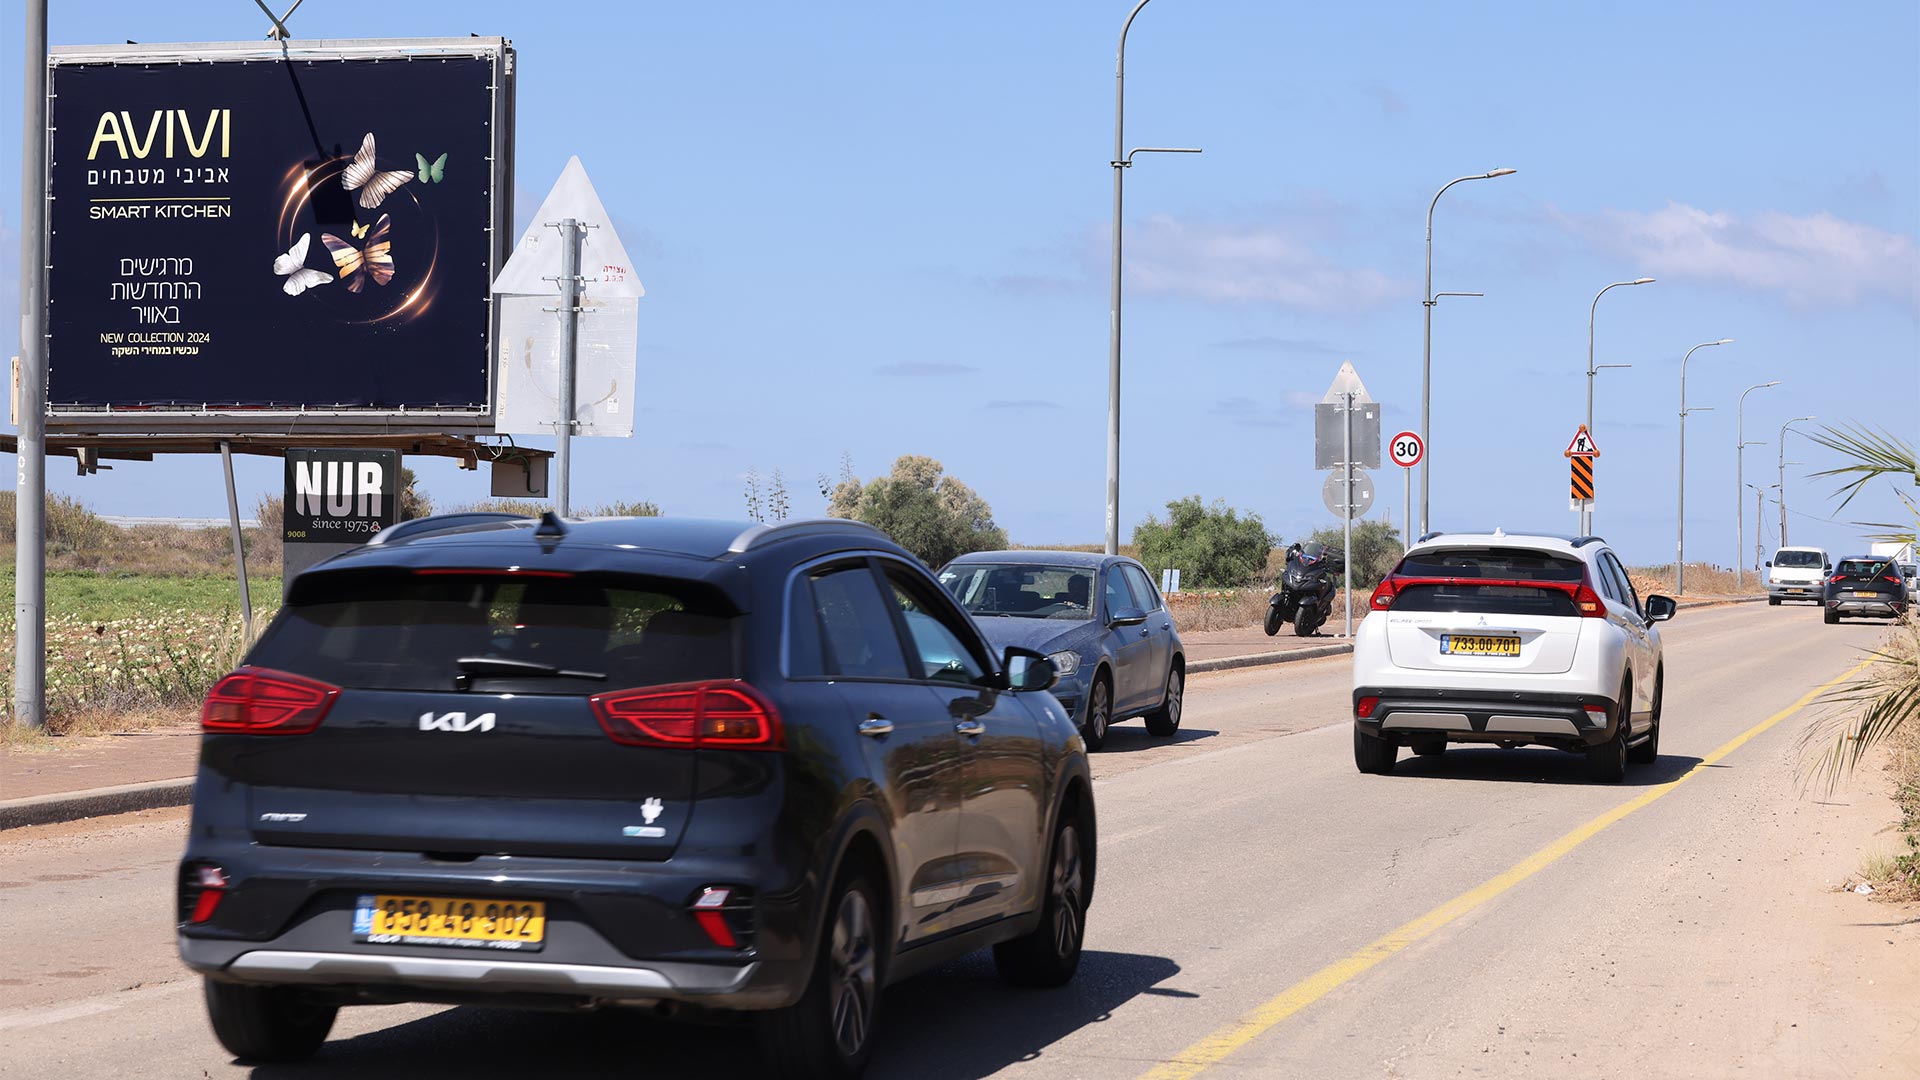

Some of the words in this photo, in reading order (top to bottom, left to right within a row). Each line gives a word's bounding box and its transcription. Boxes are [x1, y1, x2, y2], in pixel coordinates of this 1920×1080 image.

[87, 109, 231, 160] AVIVI
[87, 169, 165, 185] מטבחים
[176, 168, 229, 183] אביבי
[89, 205, 151, 219] SMART
[155, 204, 231, 218] KITCHEN
[120, 258, 193, 276] מרגישים
[110, 282, 201, 300] התחדשות
[131, 306, 180, 324] באוויר
[100, 333, 124, 343] NEW
[127, 333, 184, 343] COLLECTION
[187, 332, 210, 343] 2024
[112, 347, 139, 357] השקה
[141, 346, 171, 355] במחירי
[173, 346, 199, 355] עכשיו
[1396, 441, 1418, 457] 30
[296, 461, 383, 517] NUR
[312, 517, 341, 529] since
[343, 521, 369, 532] 1975
[287, 530, 306, 538] 9008
[419, 711, 496, 732] KIA
